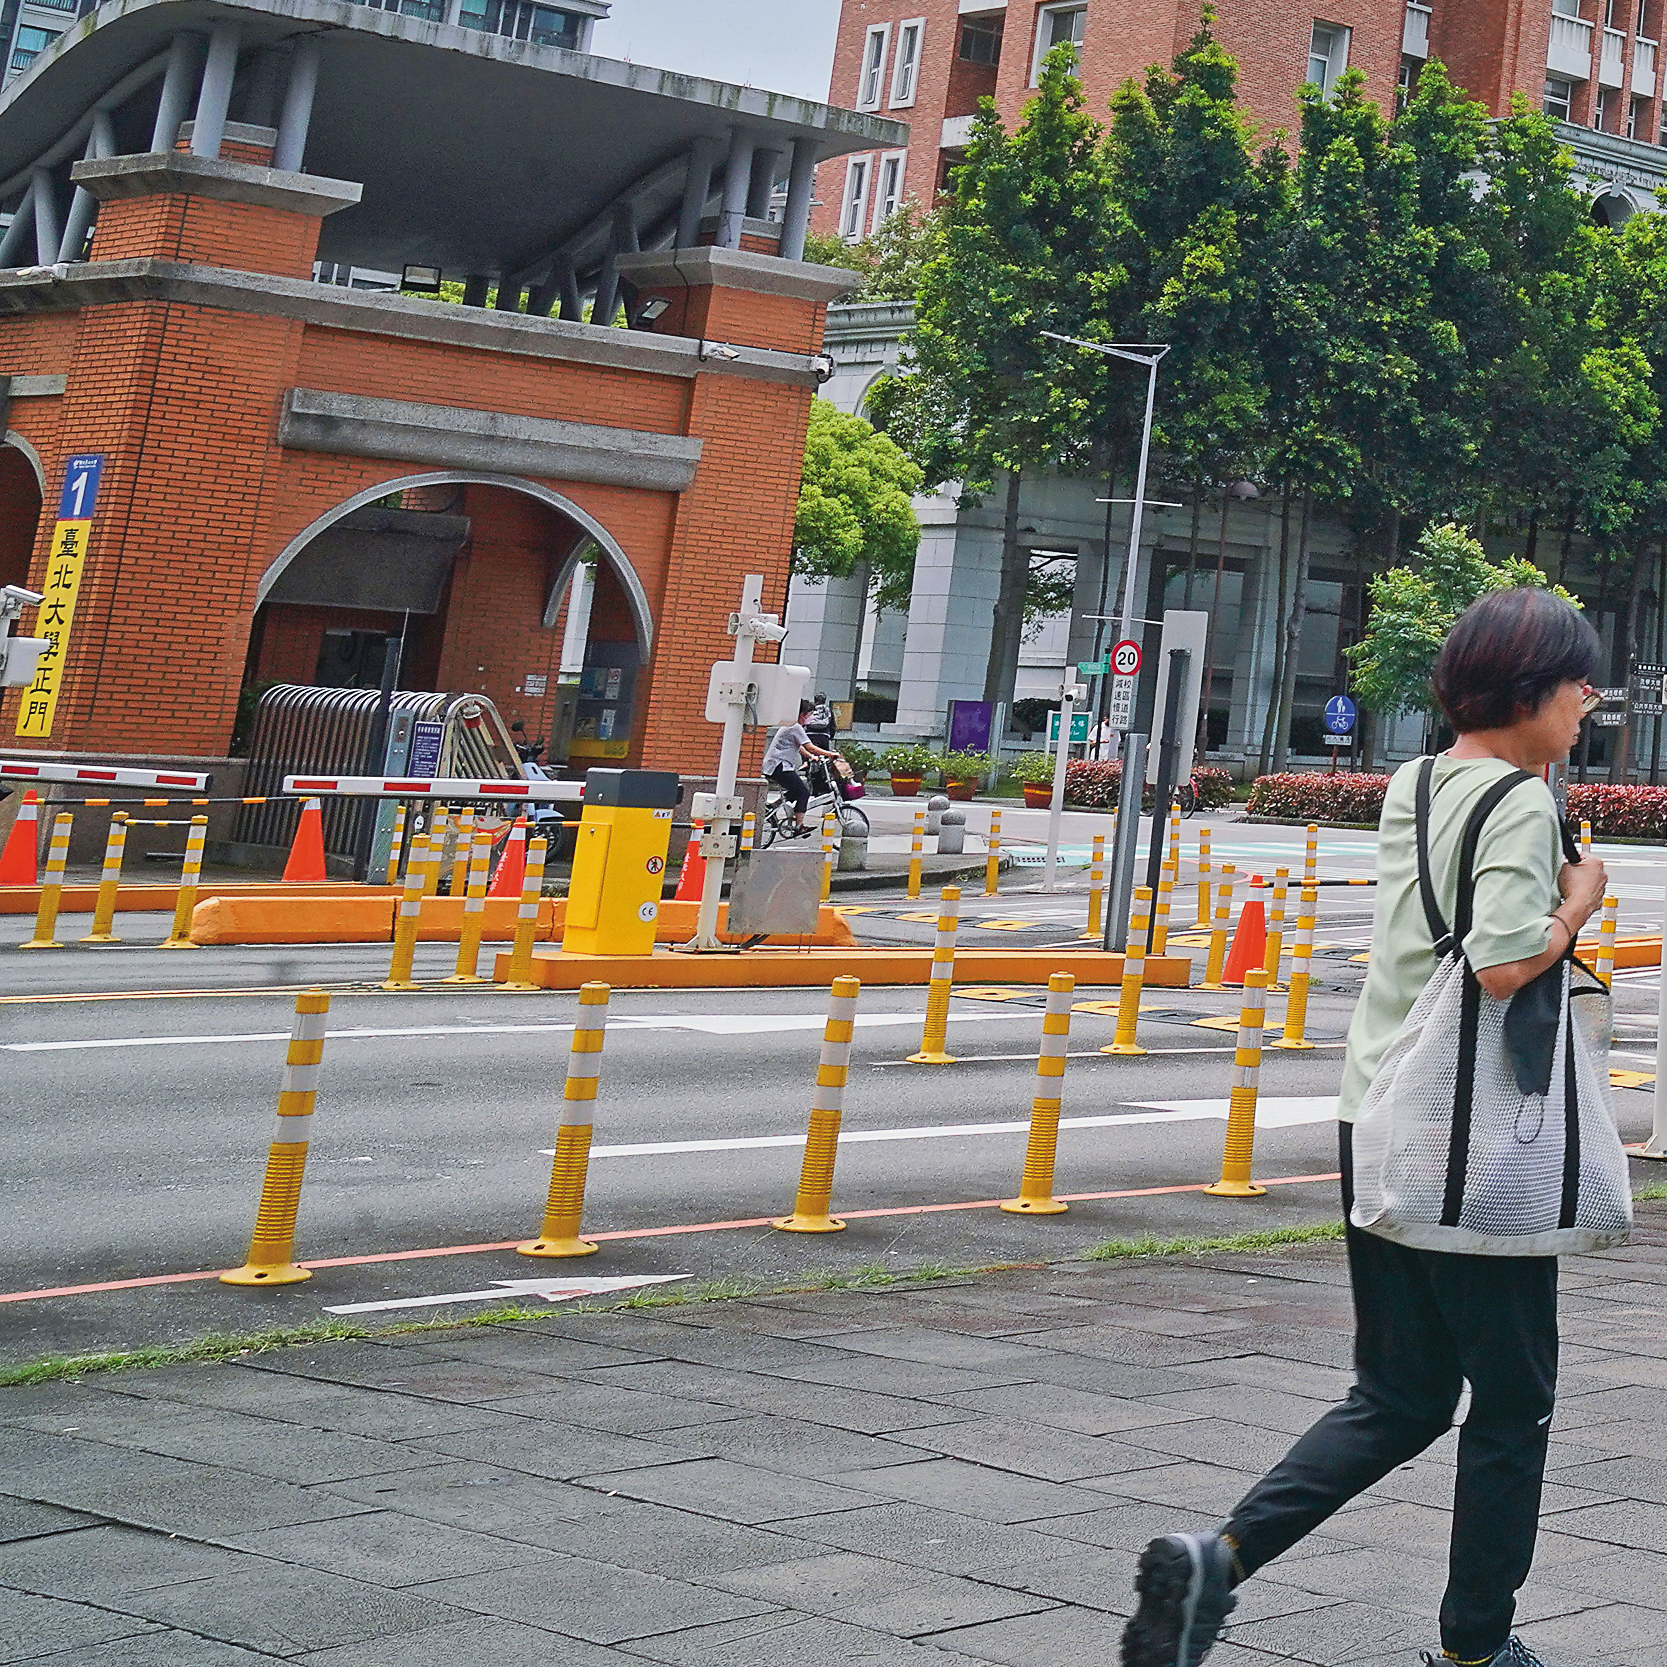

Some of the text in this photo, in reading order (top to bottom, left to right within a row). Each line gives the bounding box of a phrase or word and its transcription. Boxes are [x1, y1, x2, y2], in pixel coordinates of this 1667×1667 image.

[71, 471, 89, 516] 1
[23, 528, 79, 732] 臺北大學正門
[1117, 651, 1136, 666] 20
